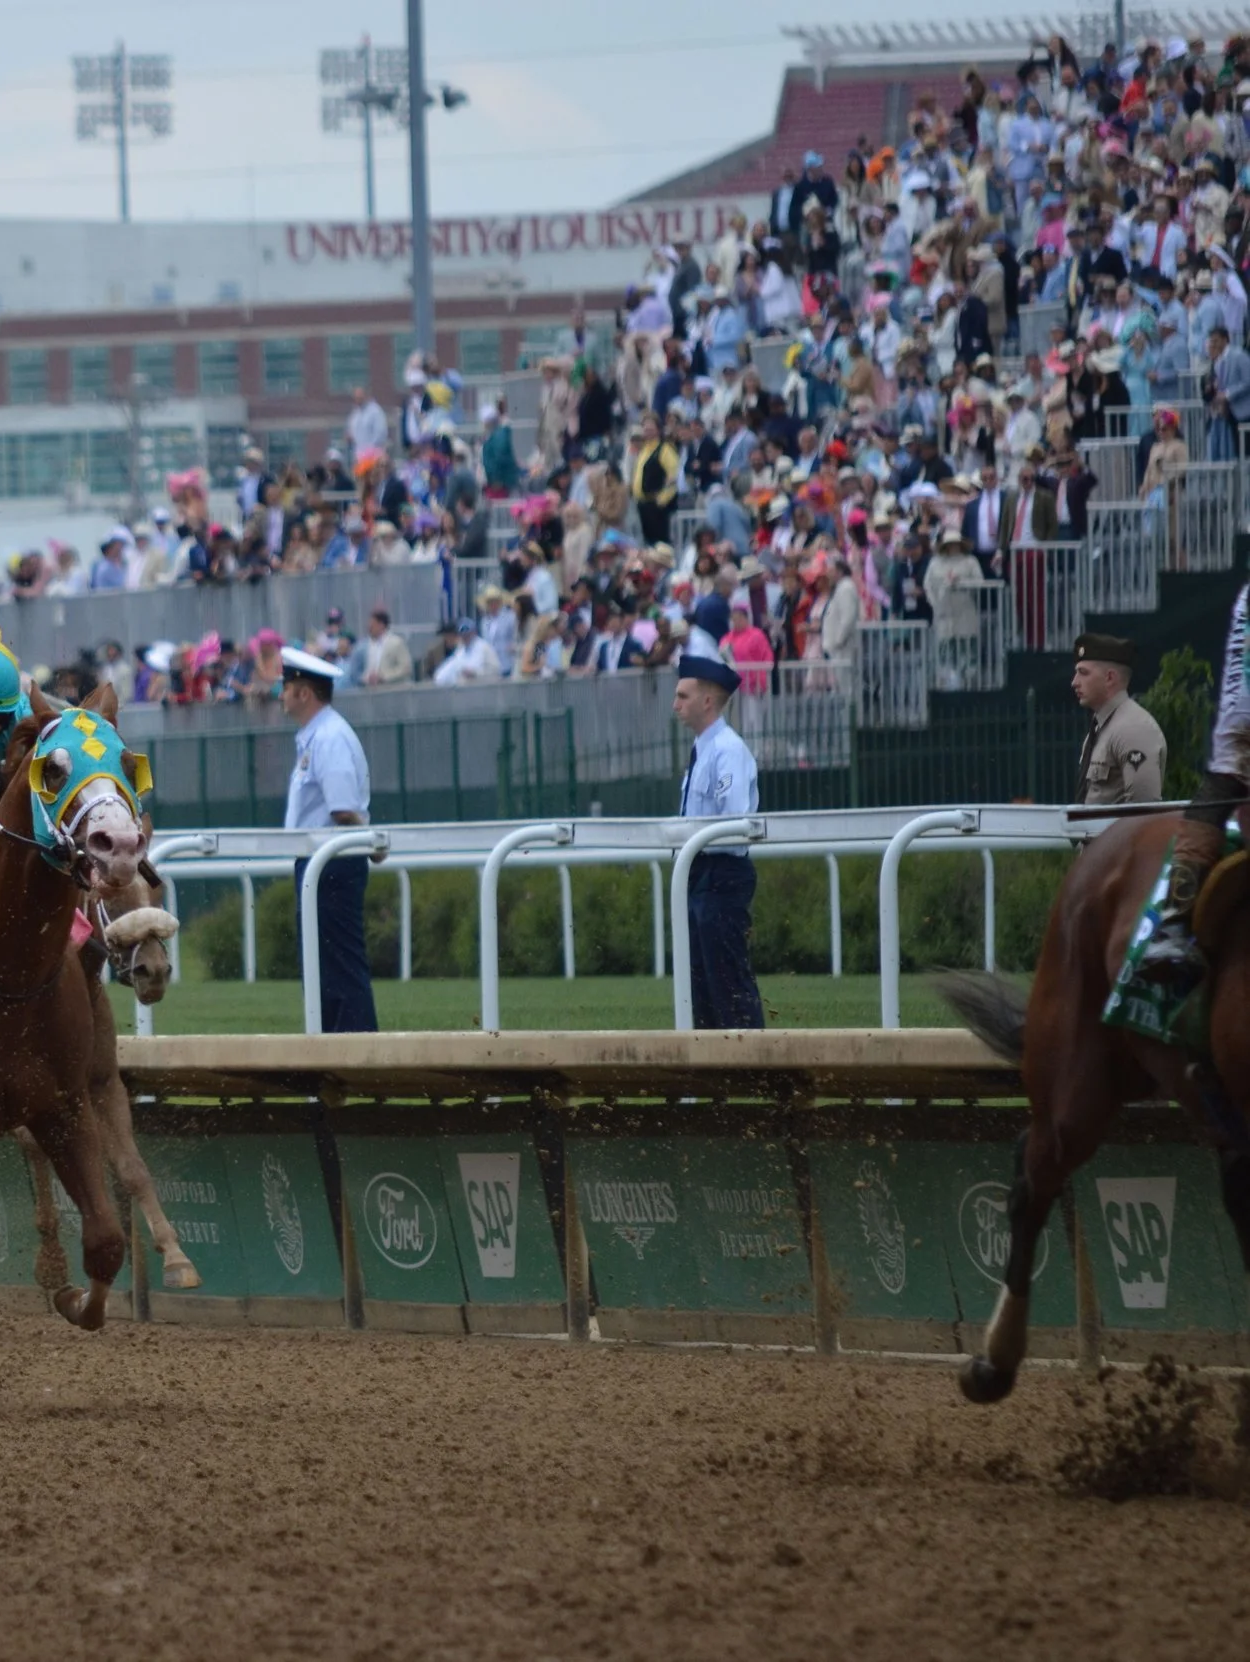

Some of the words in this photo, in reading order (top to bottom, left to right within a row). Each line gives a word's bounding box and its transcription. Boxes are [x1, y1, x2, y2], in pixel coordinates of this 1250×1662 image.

[157, 1180, 218, 1204] OODFORD
[583, 1182, 679, 1224] LONGINES
[701, 1185, 781, 1213] WOODFORD
[172, 1220, 220, 1245] SERVE
[378, 1183, 425, 1252] Ford
[467, 1180, 514, 1249] SAP
[1104, 1200, 1167, 1284] SAP
